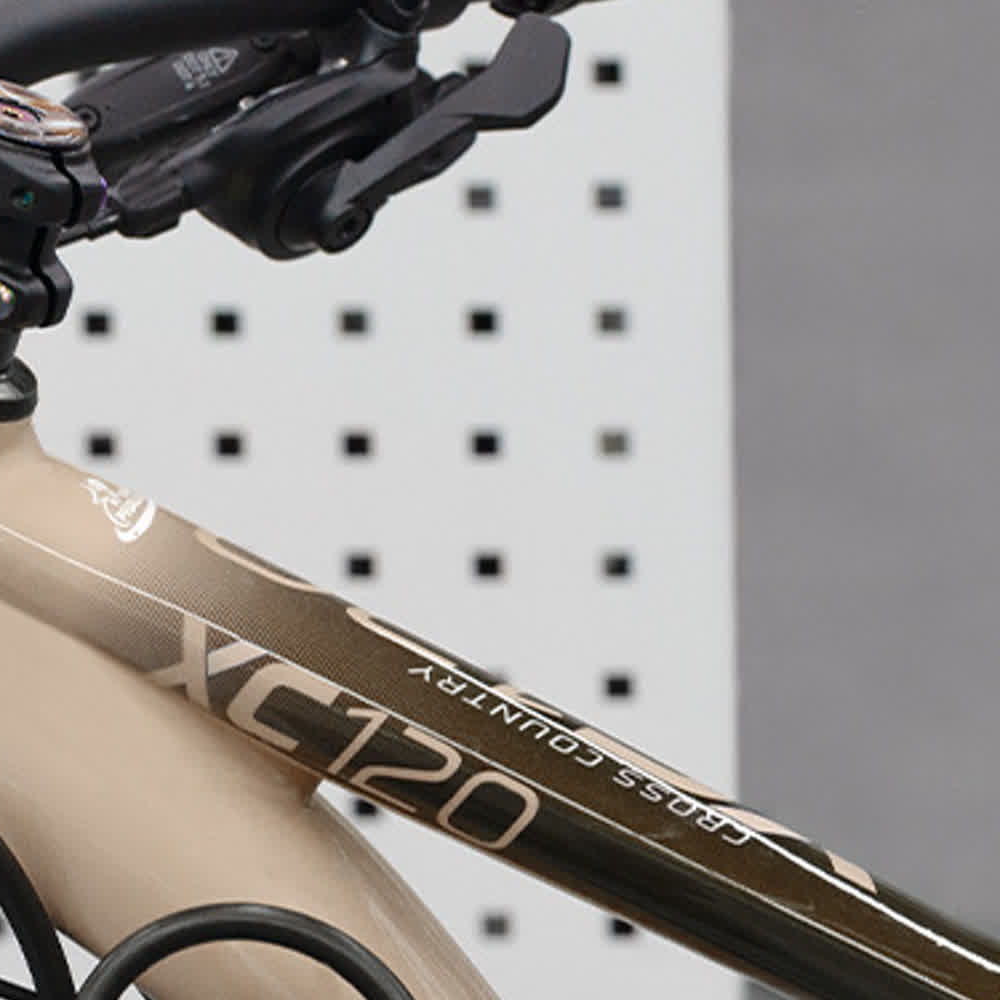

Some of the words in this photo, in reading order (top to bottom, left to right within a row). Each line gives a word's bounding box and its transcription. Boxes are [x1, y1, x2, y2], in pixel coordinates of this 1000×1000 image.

[153, 615, 540, 851] XC120
[408, 664, 604, 768] COUNTRY
[610, 763, 752, 847] CROSS
